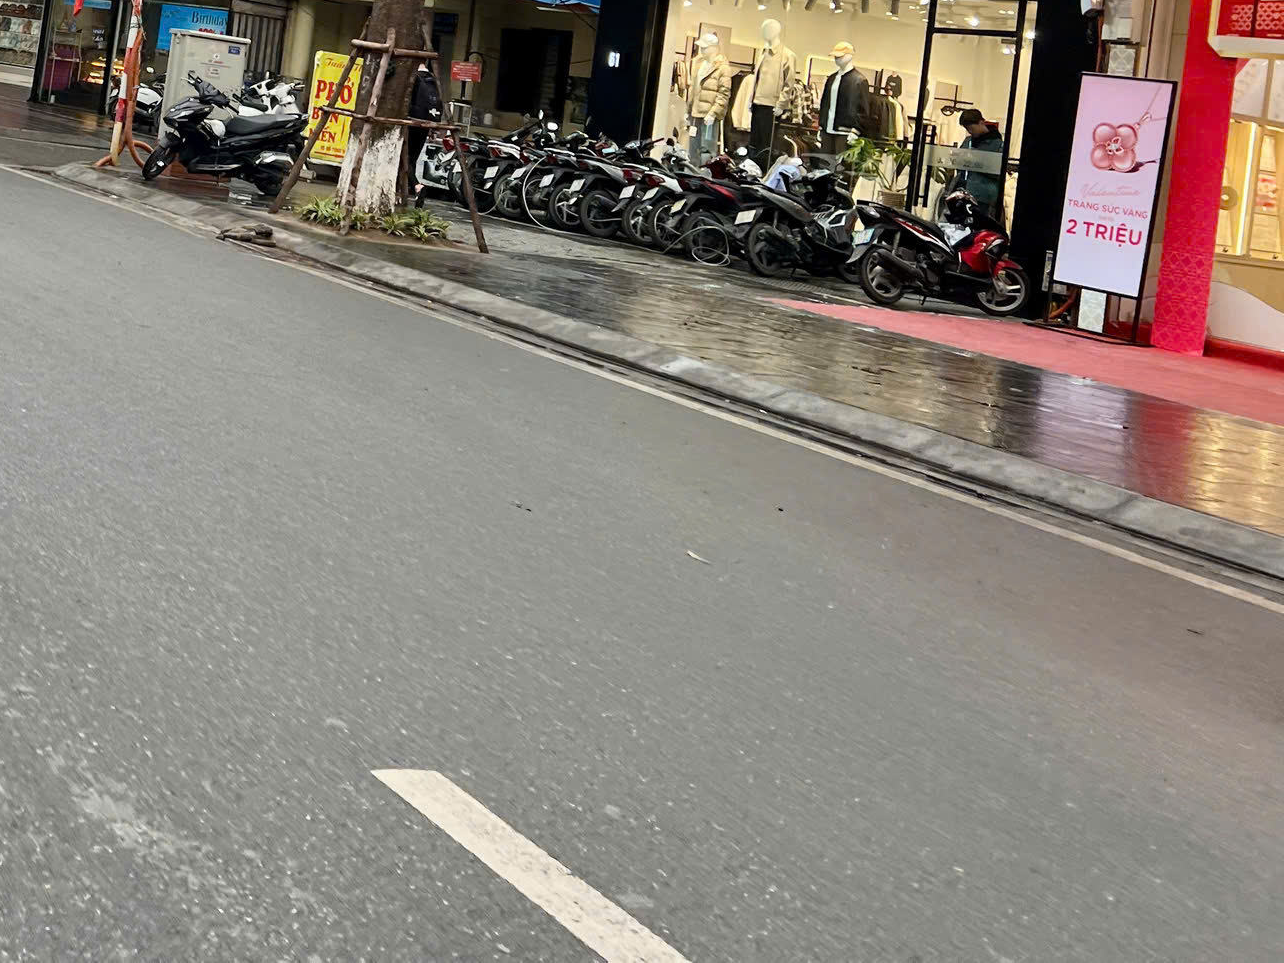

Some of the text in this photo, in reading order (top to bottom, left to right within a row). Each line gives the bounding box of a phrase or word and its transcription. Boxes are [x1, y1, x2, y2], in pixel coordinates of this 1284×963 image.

[1068, 199, 1099, 211] TRANG
[1066, 219, 1142, 247] 2 TRIỆU
